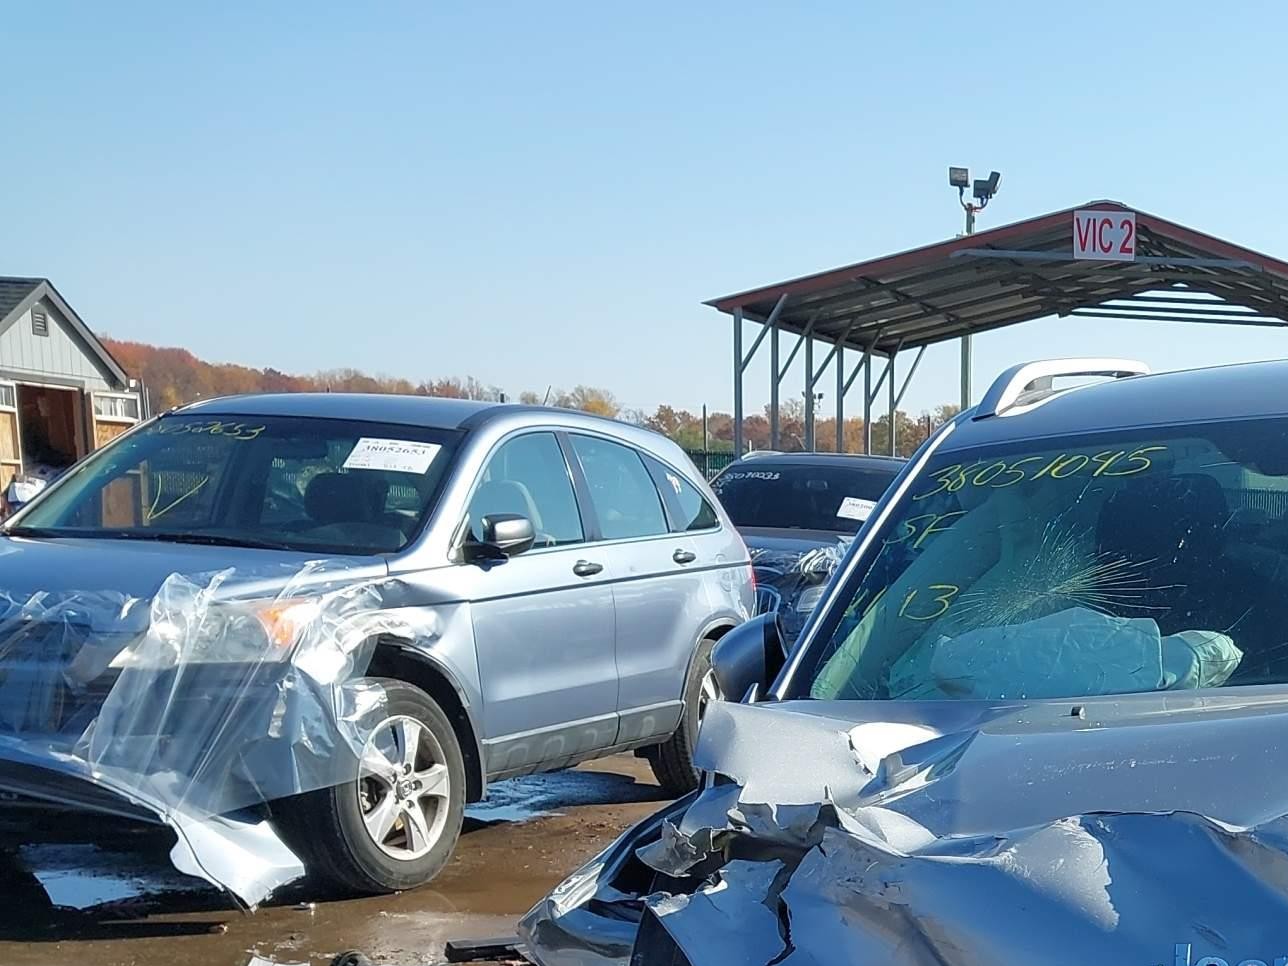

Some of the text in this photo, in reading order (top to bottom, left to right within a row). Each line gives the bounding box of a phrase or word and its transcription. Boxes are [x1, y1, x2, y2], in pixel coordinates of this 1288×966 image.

[1075, 217, 1134, 255] VIC 2
[912, 445, 1169, 501] 38051045
